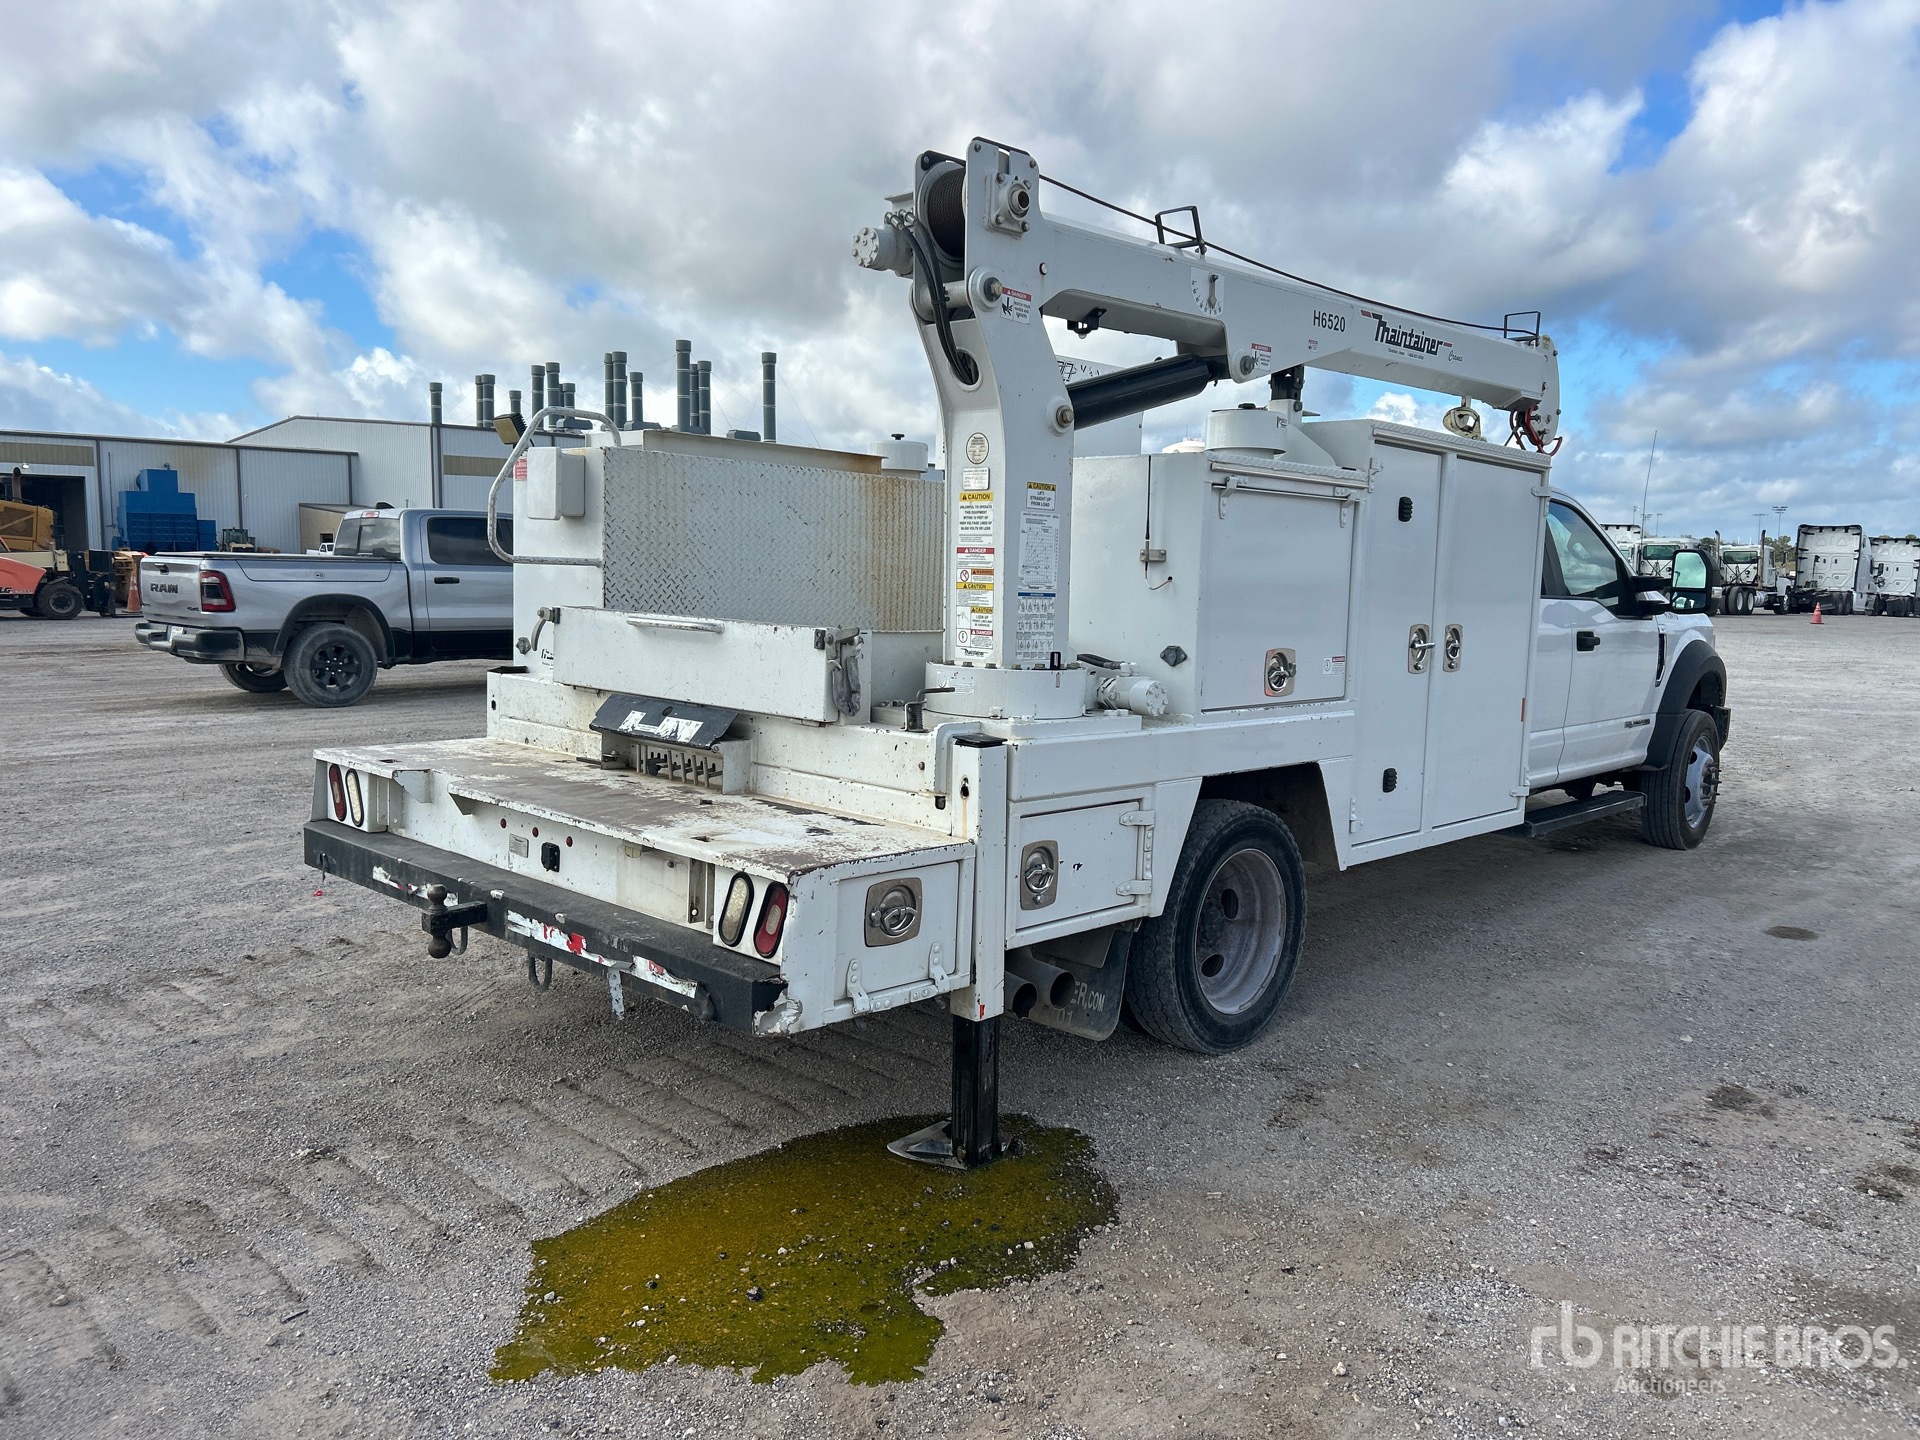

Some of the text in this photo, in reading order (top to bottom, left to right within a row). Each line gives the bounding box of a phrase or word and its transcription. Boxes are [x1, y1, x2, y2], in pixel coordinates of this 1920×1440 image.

[1011, 291, 1027, 299] DANGER
[1313, 309, 1346, 333] H6520
[1372, 312, 1444, 355] Maintainer
[151, 584, 178, 594] RAM
